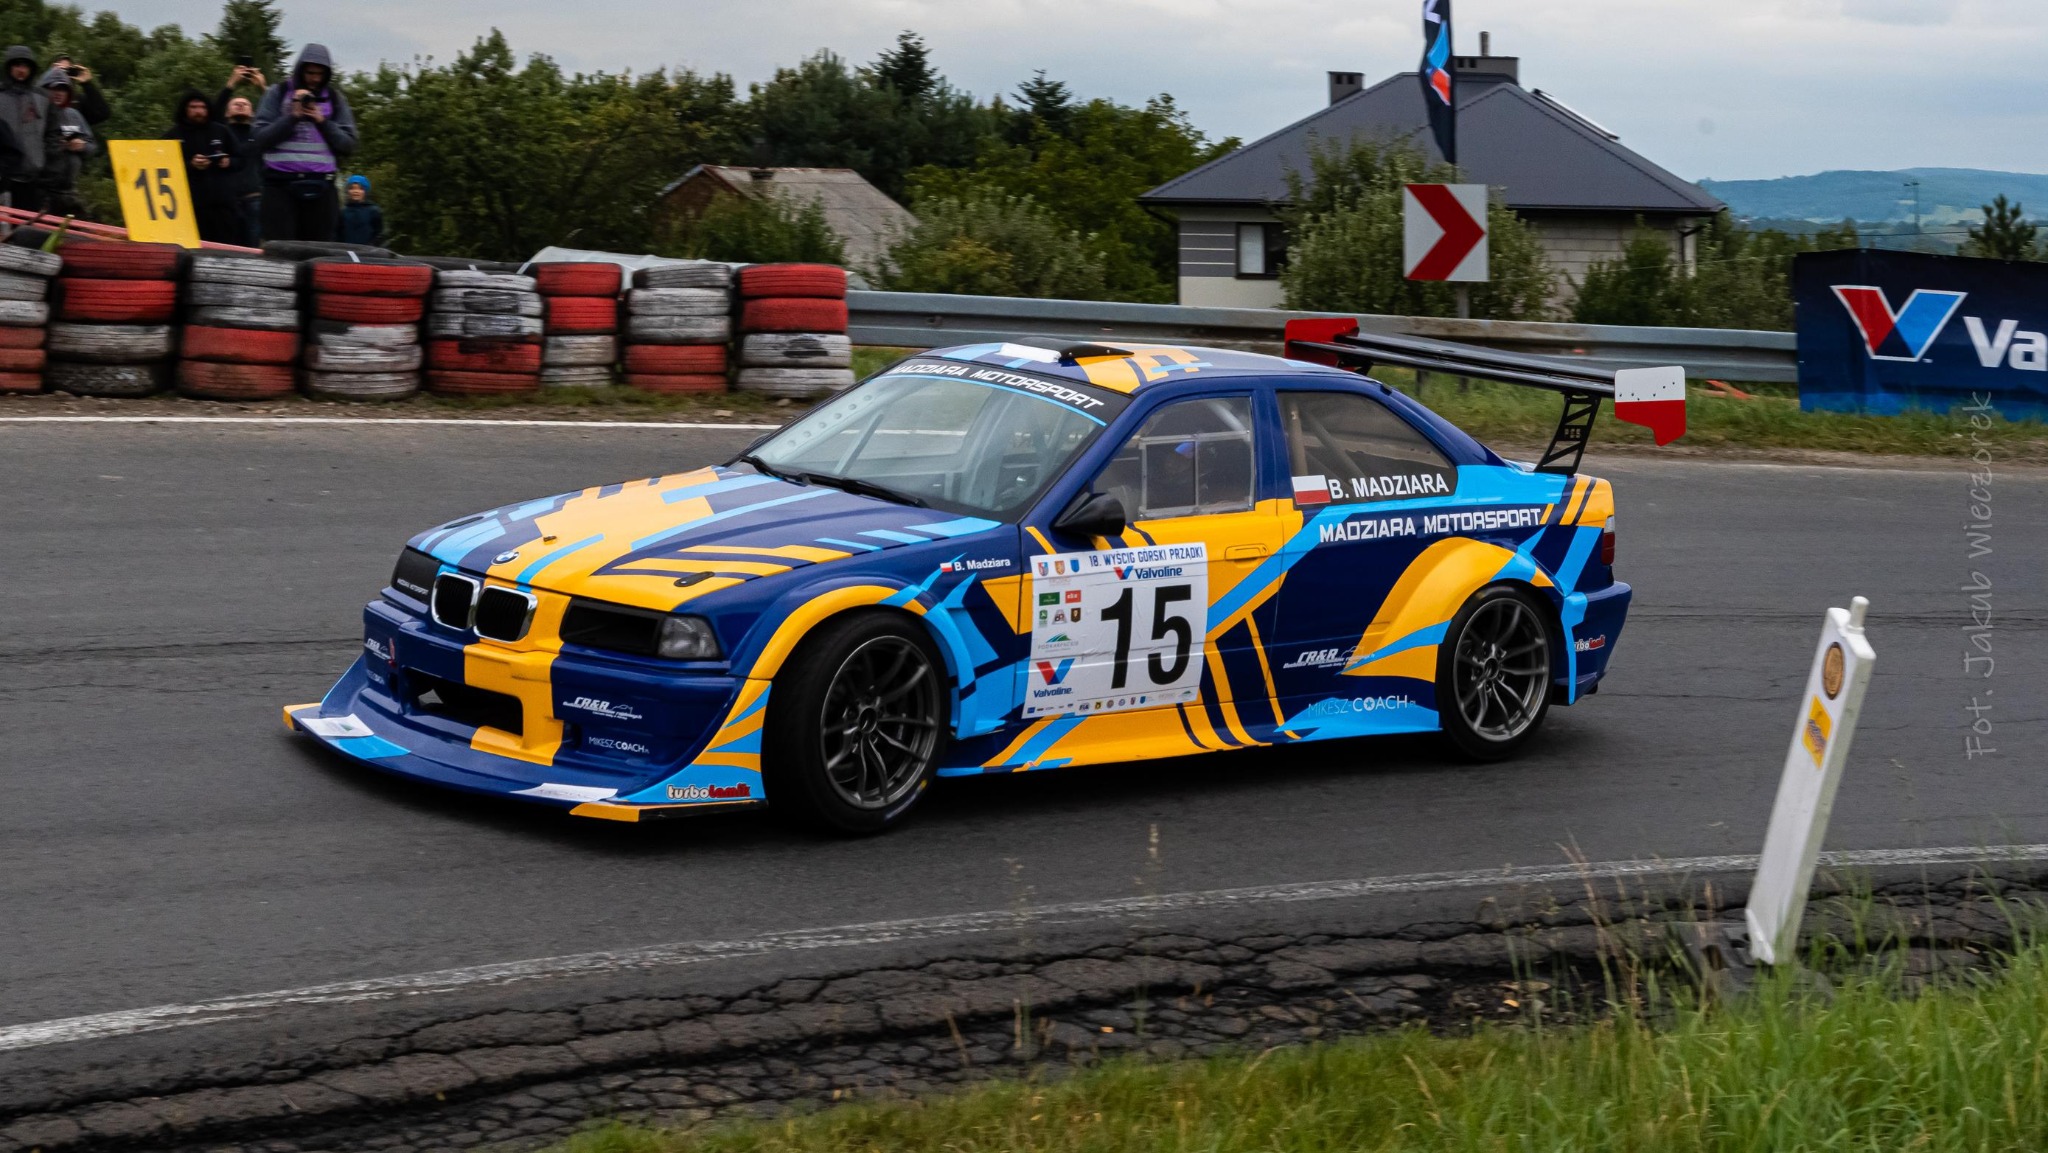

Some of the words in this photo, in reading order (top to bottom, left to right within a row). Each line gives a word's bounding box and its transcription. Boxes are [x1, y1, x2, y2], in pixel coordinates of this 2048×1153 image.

[135, 168, 178, 221] 15
[1962, 316, 2048, 371] Va
[887, 363, 969, 379] MADZIARA
[970, 369, 1105, 409] MOTORSPORT
[1328, 479, 1350, 499] B.
[1351, 473, 1449, 498] MADZIARA
[1319, 517, 1416, 543] MADZIARA
[1424, 508, 1541, 534] MOTORSPORT
[954, 561, 965, 572] B.
[966, 558, 1011, 570] Madziara
[1088, 555, 1102, 567] 18.
[1103, 550, 1135, 566] WYŚCIG
[1138, 548, 1167, 563] GÓRSKI
[1169, 546, 1204, 561] PRZĄDKI
[1135, 566, 1183, 579] Valvoline
[1101, 584, 1192, 689] 15
[1297, 648, 1339, 664] CR&R
[573, 696, 610, 710] CR&R
[1033, 687, 1073, 698] Valvoline
